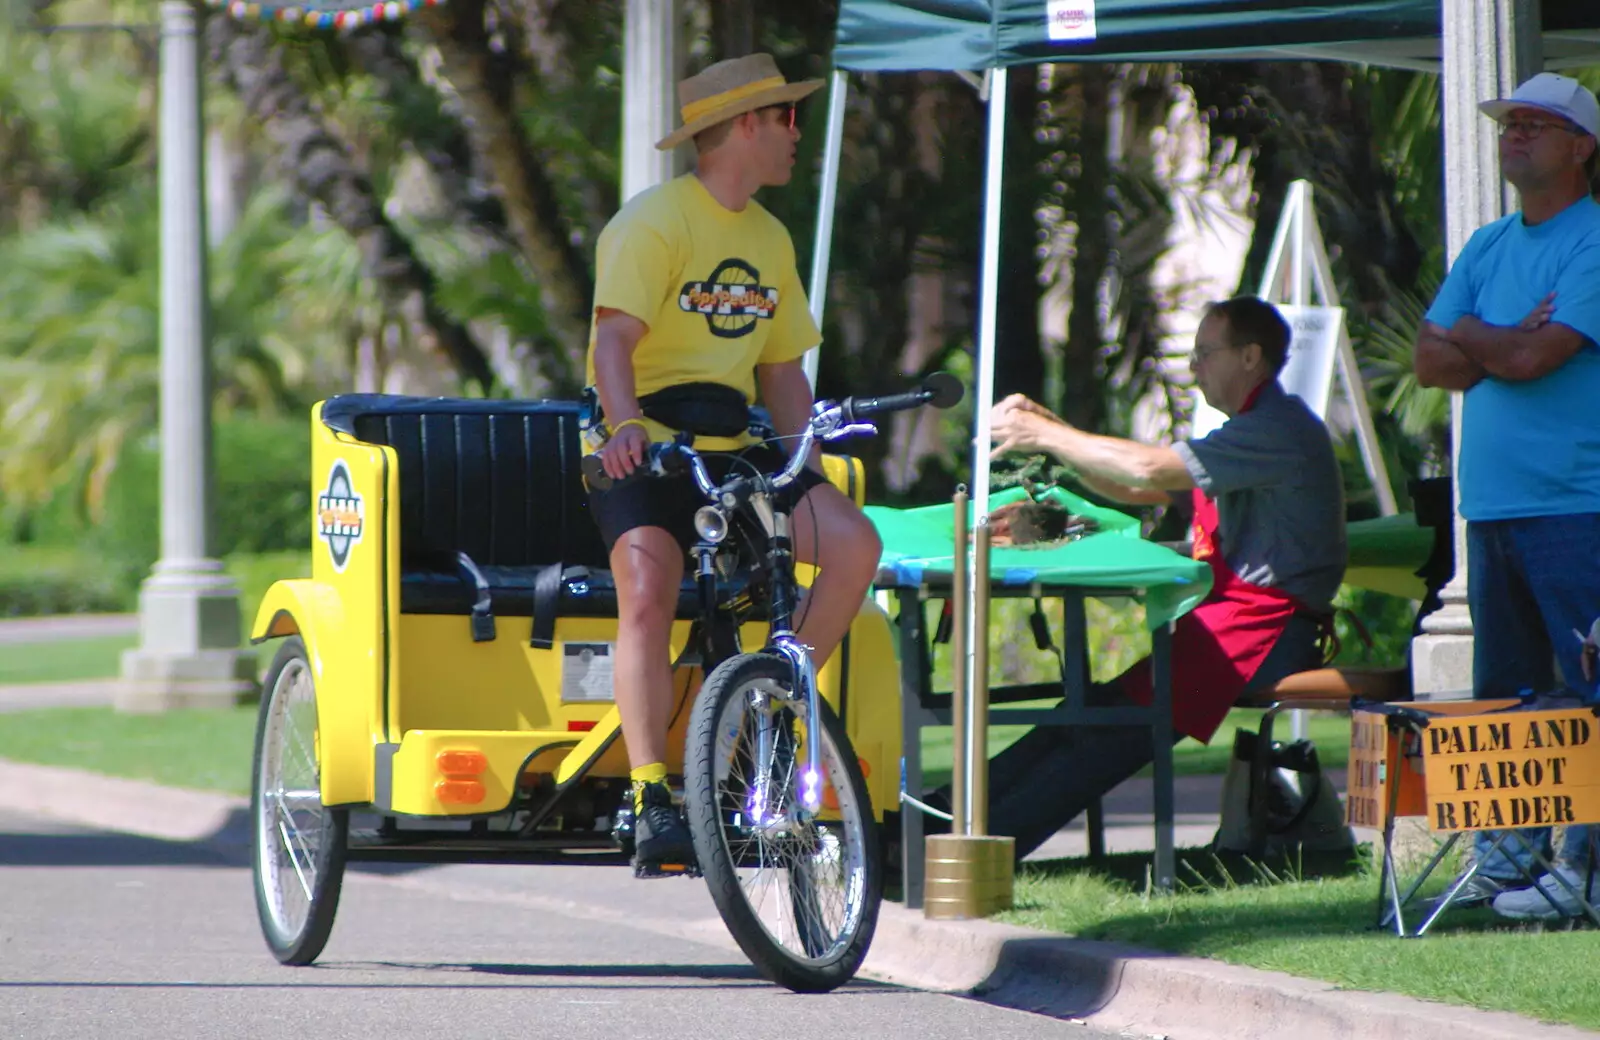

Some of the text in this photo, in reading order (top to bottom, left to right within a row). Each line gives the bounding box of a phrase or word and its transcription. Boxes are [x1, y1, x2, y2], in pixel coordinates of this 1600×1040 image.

[1429, 718, 1590, 755] PALM AND
[1450, 757, 1567, 791] TAROT
[1435, 795, 1576, 830] READER
